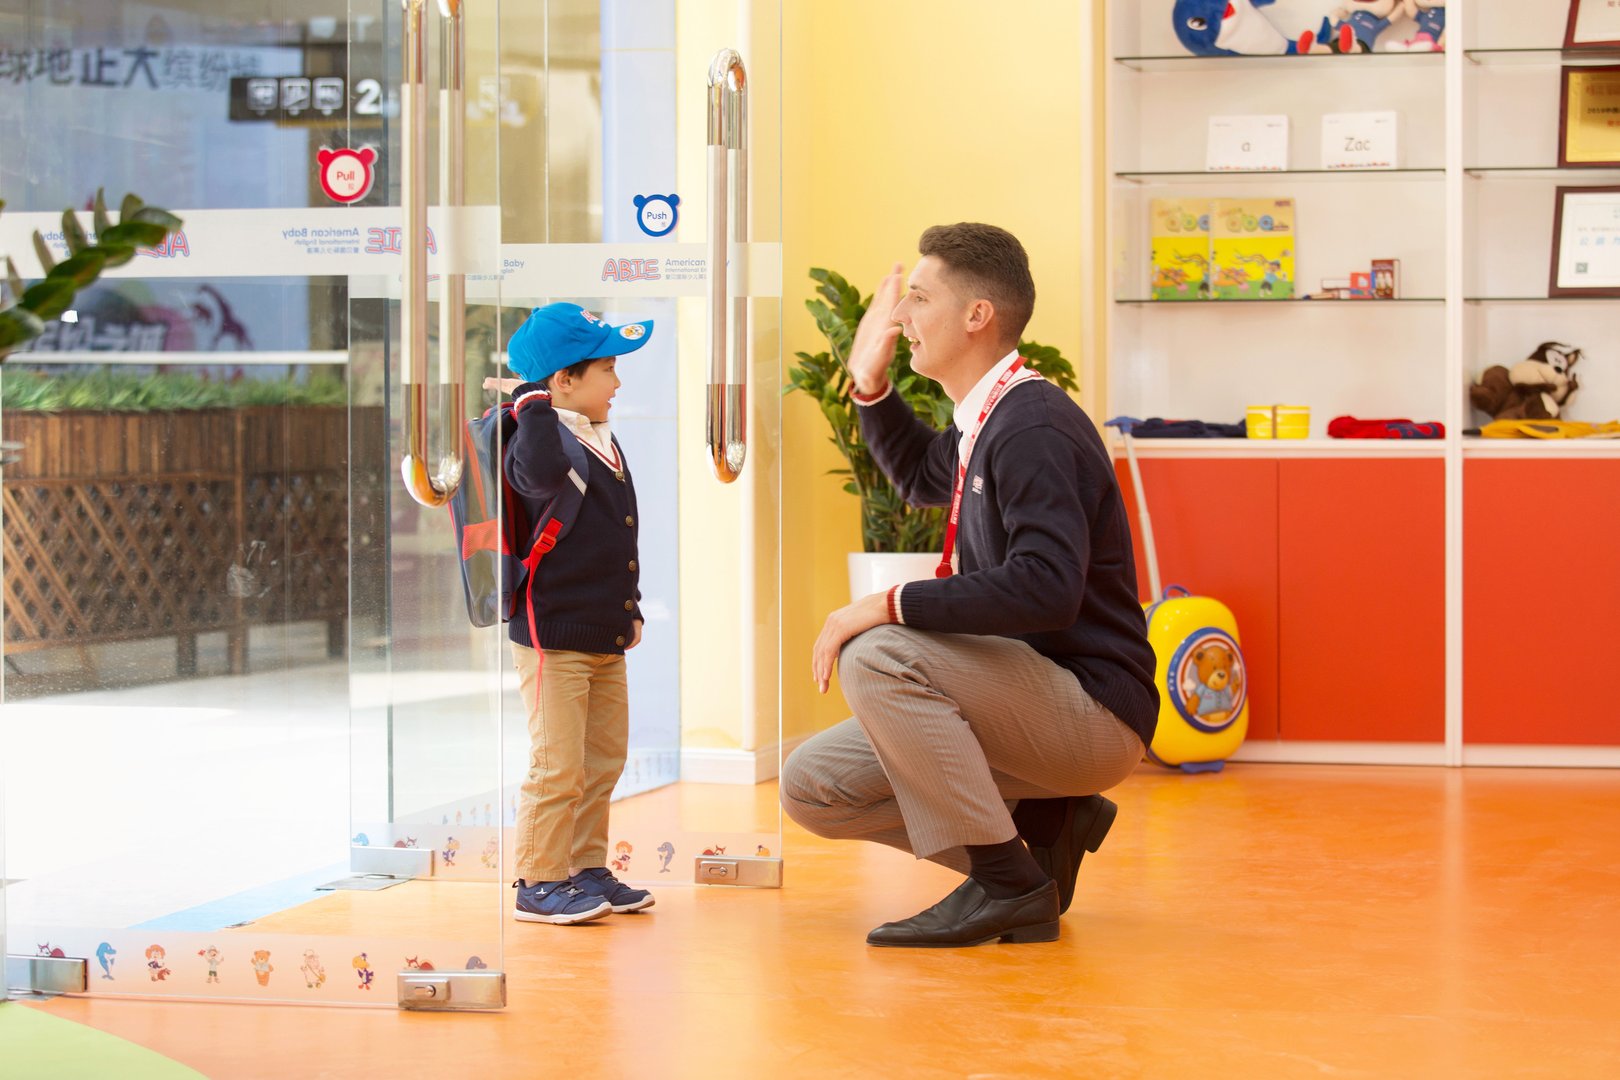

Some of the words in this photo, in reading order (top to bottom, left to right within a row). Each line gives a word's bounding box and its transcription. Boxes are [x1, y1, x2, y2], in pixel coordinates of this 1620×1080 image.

[1344, 136, 1371, 152] Zac
[336, 171, 355, 181] Pull
[646, 211, 667, 220] Push
[503, 258, 525, 268] Baby
[665, 257, 706, 267] American
[601, 257, 661, 282] ABIE
